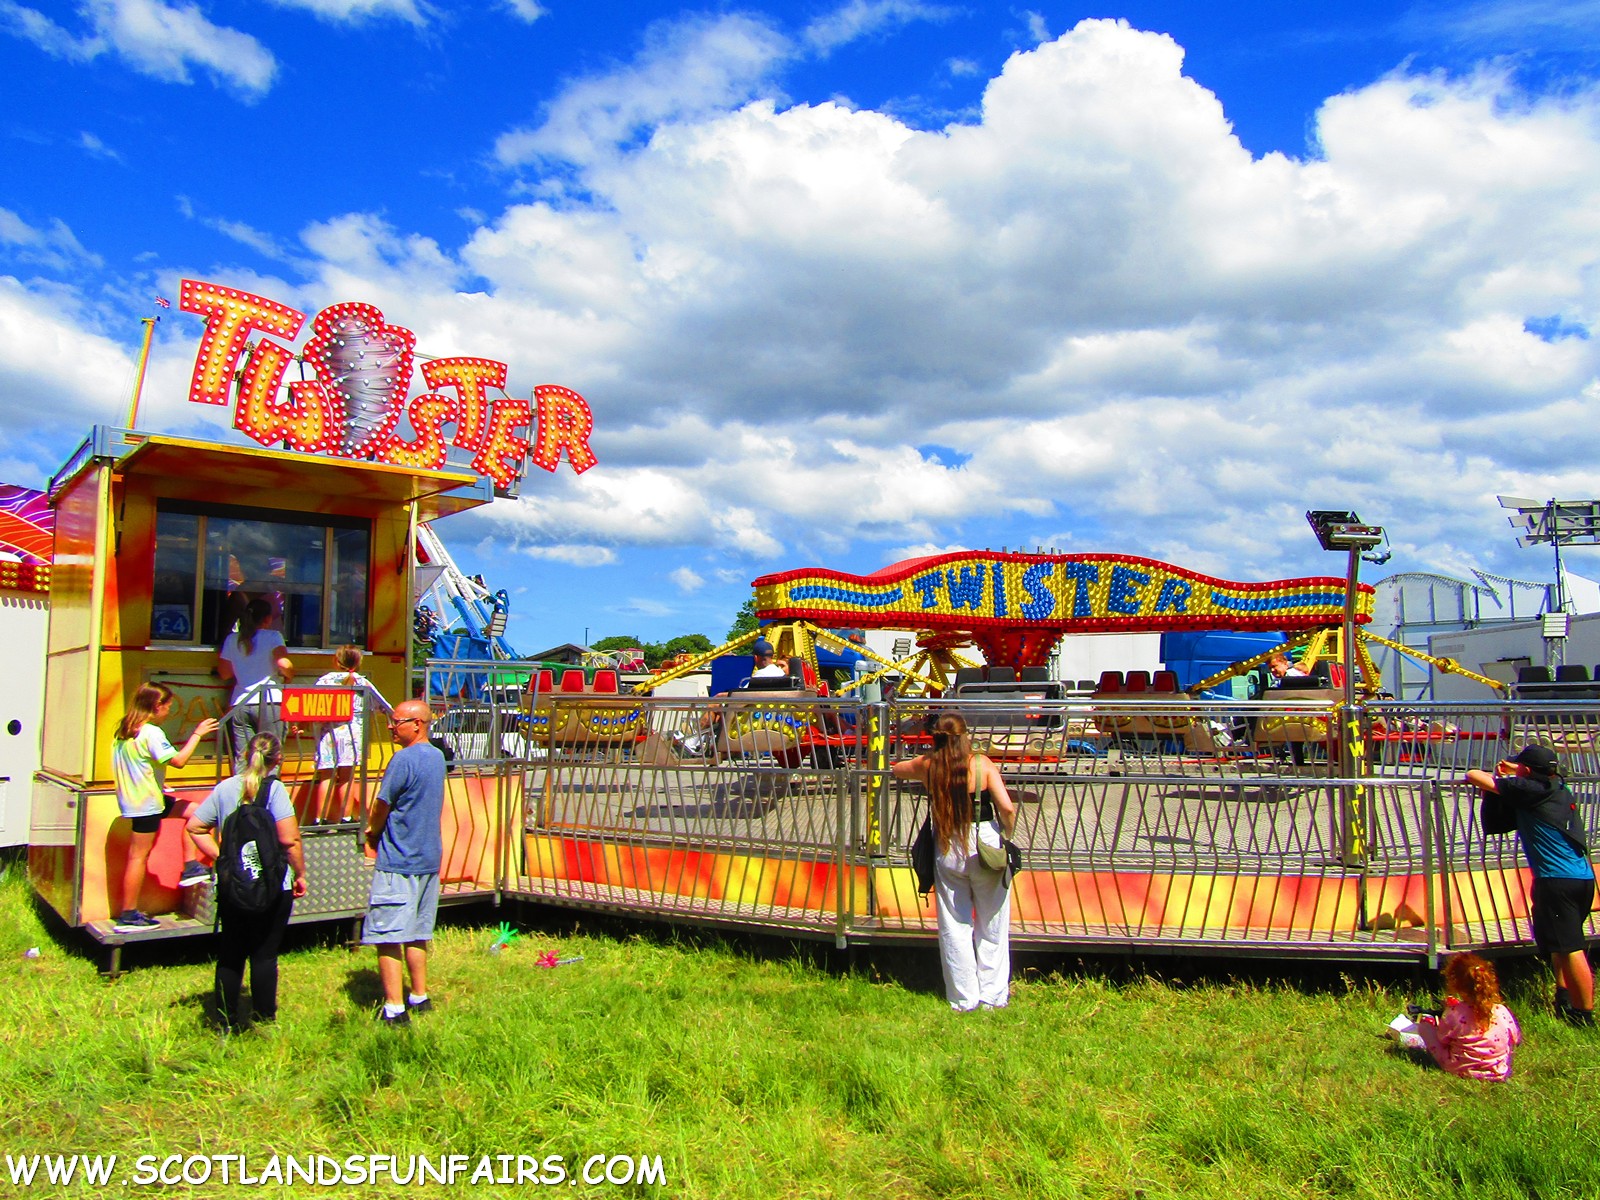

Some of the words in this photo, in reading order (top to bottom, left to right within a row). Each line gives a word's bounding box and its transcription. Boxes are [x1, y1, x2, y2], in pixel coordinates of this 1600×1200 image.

[914, 561, 1193, 622] TWISTER
[159, 616, 186, 634] £4
[302, 693, 334, 717] WAY
[336, 694, 351, 717] IN
